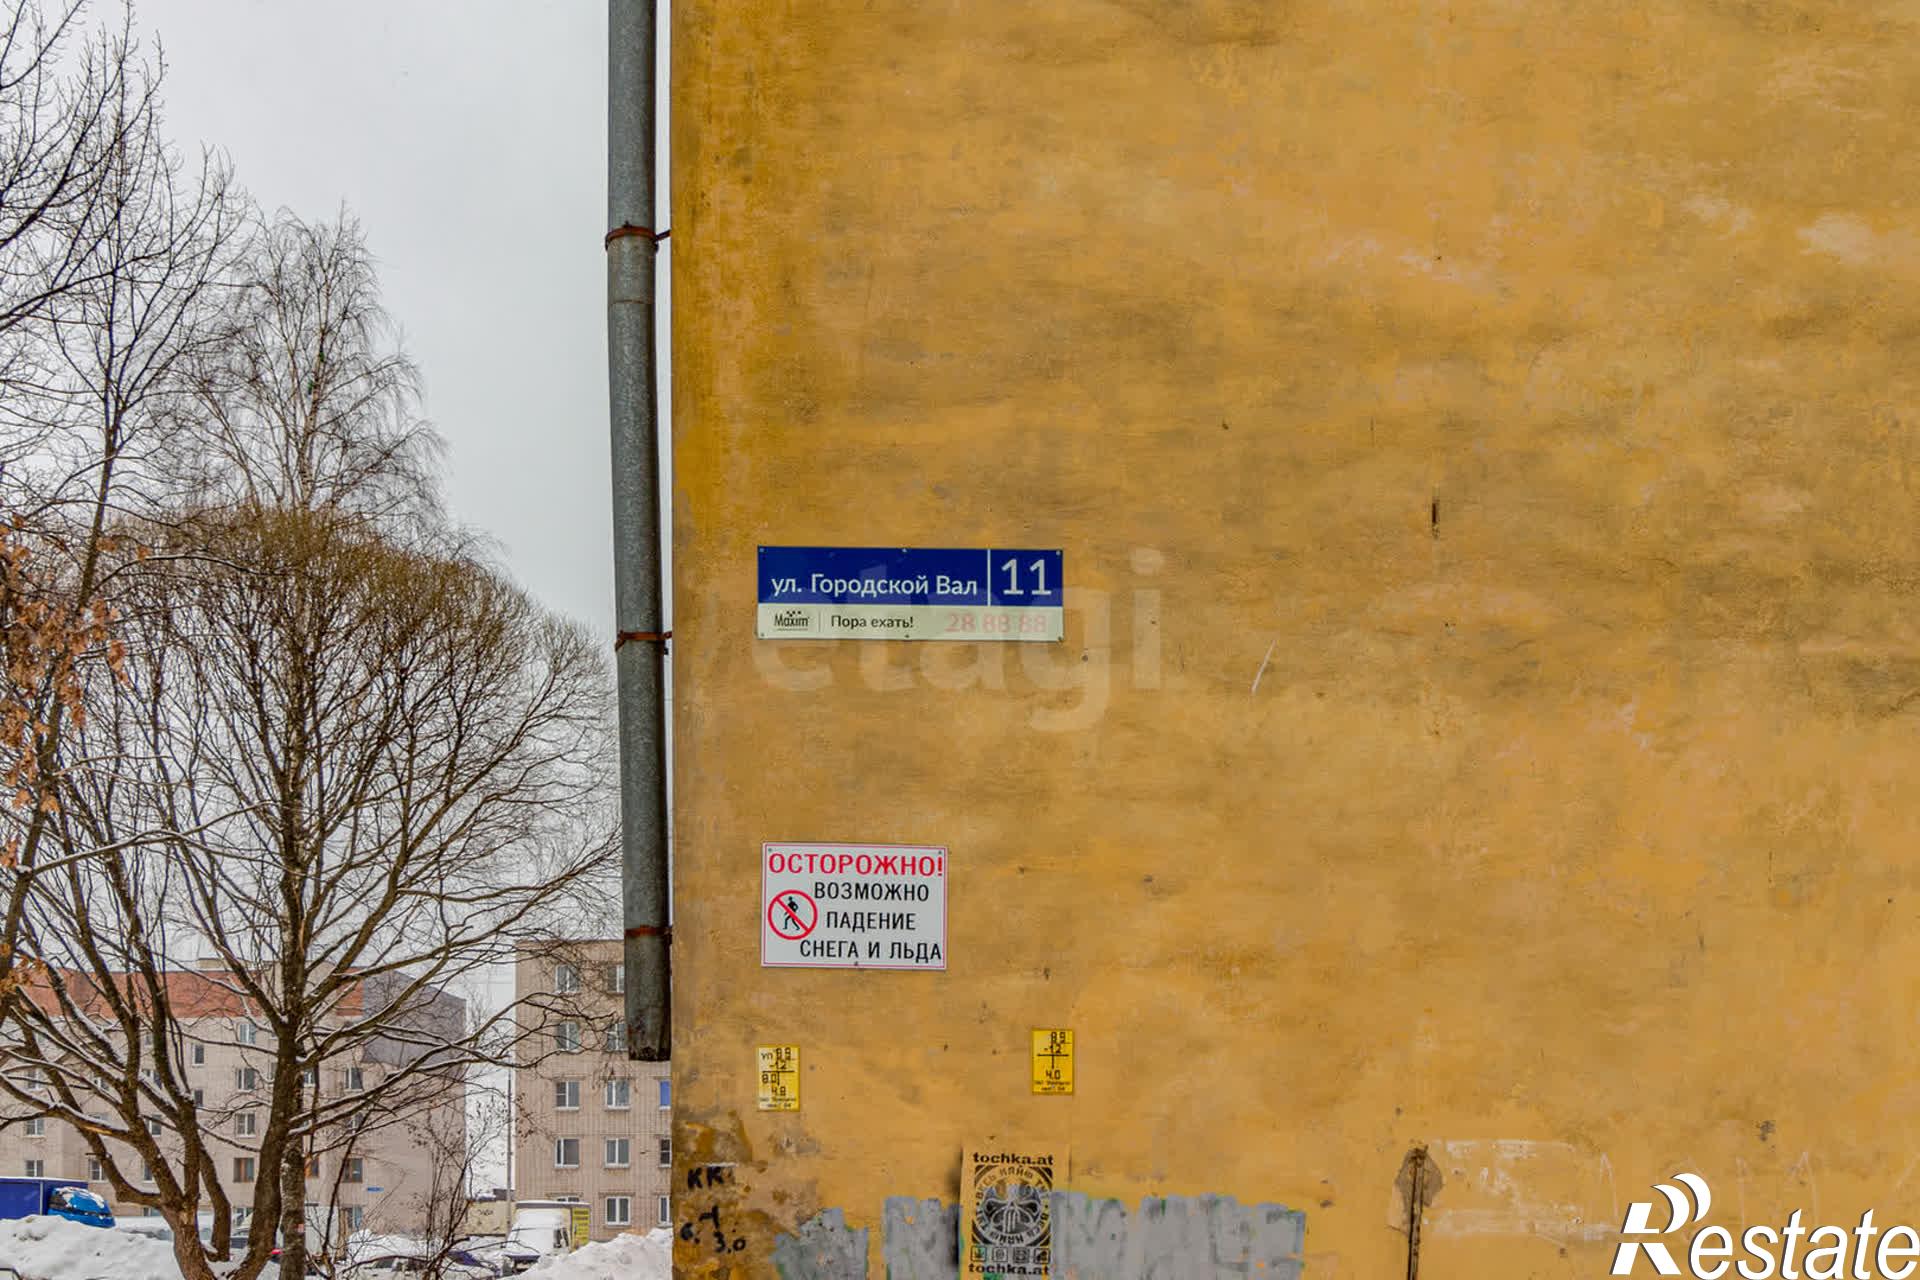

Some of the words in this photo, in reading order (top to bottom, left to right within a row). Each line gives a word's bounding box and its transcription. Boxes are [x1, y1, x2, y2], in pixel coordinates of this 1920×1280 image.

[771, 578, 802, 596] ул.
[811, 573, 929, 598] Городской
[936, 575, 977, 595] Вал
[1001, 558, 1052, 595] 11
[831, 615, 867, 630] Пора
[871, 616, 914, 628] ехать!
[944, 612, 976, 632] 28
[768, 853, 943, 877] ОСТОРОЖНО!
[814, 881, 929, 902] ВОЗМОЖНО
[826, 911, 916, 933] ПАДЕНИЕ
[800, 940, 859, 958] СНЕГА
[868, 942, 880, 959] И
[889, 942, 942, 963] ЛЬДА
[973, 1152, 1054, 1165] tochka.at
[968, 1263, 1050, 1275] tochka.at
